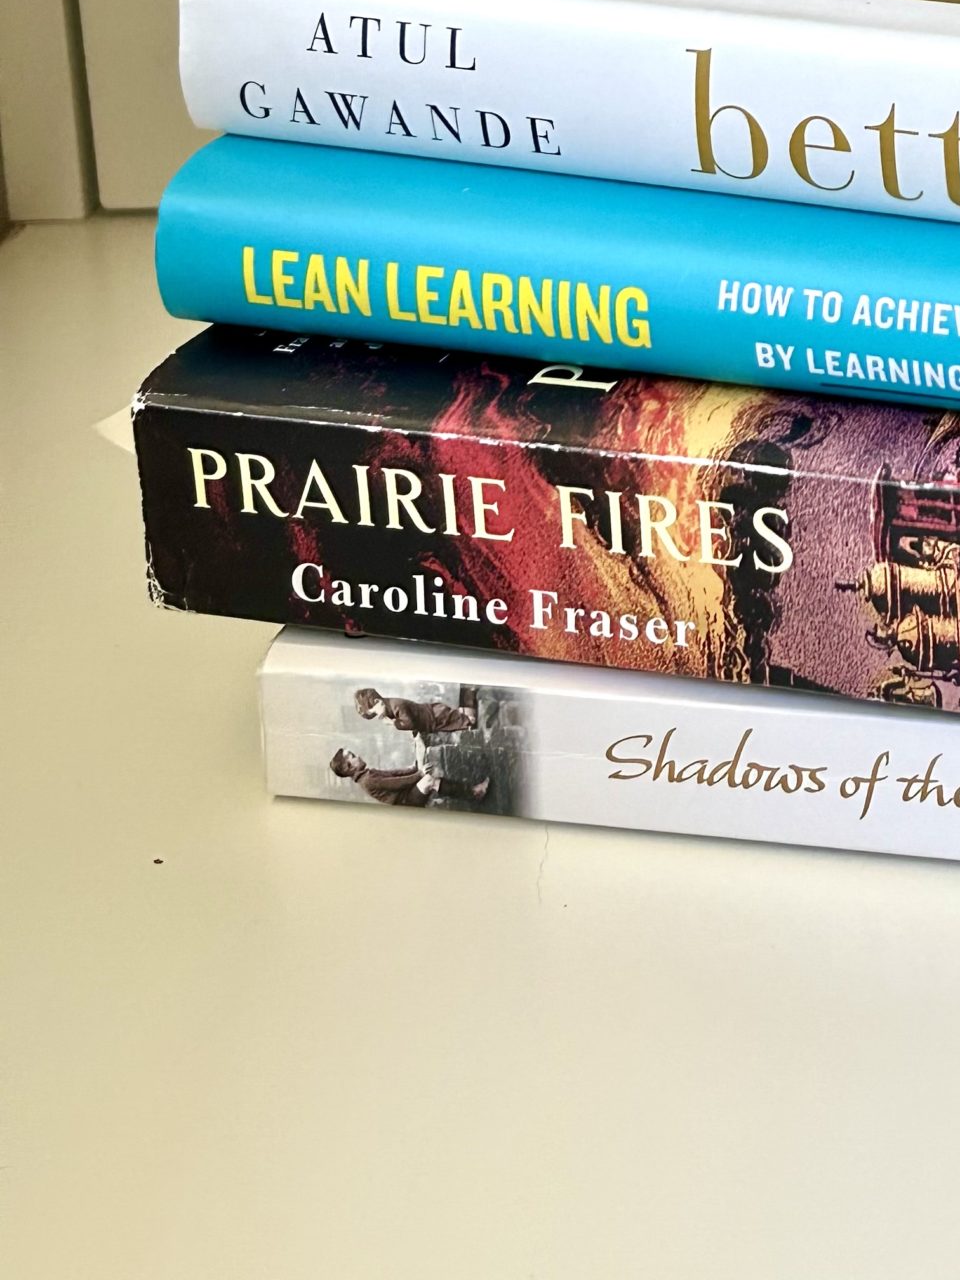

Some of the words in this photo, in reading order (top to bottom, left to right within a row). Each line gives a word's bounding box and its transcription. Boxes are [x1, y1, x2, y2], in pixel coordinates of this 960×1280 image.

[306, 12, 477, 72] ATUL
[239, 80, 563, 157] GAWANDE
[242, 246, 372, 318] LEAN
[386, 262, 652, 349] LEARNING
[718, 279, 795, 317] HOW
[803, 289, 842, 323] TO
[755, 342, 795, 370] BY
[187, 447, 514, 542] PRAIRIE
[554, 485, 794, 574] FIRES
[291, 562, 508, 625] Caroline
[529, 589, 696, 647] Fraser
[605, 727, 826, 794] Shadows
[840, 751, 890, 819] of
